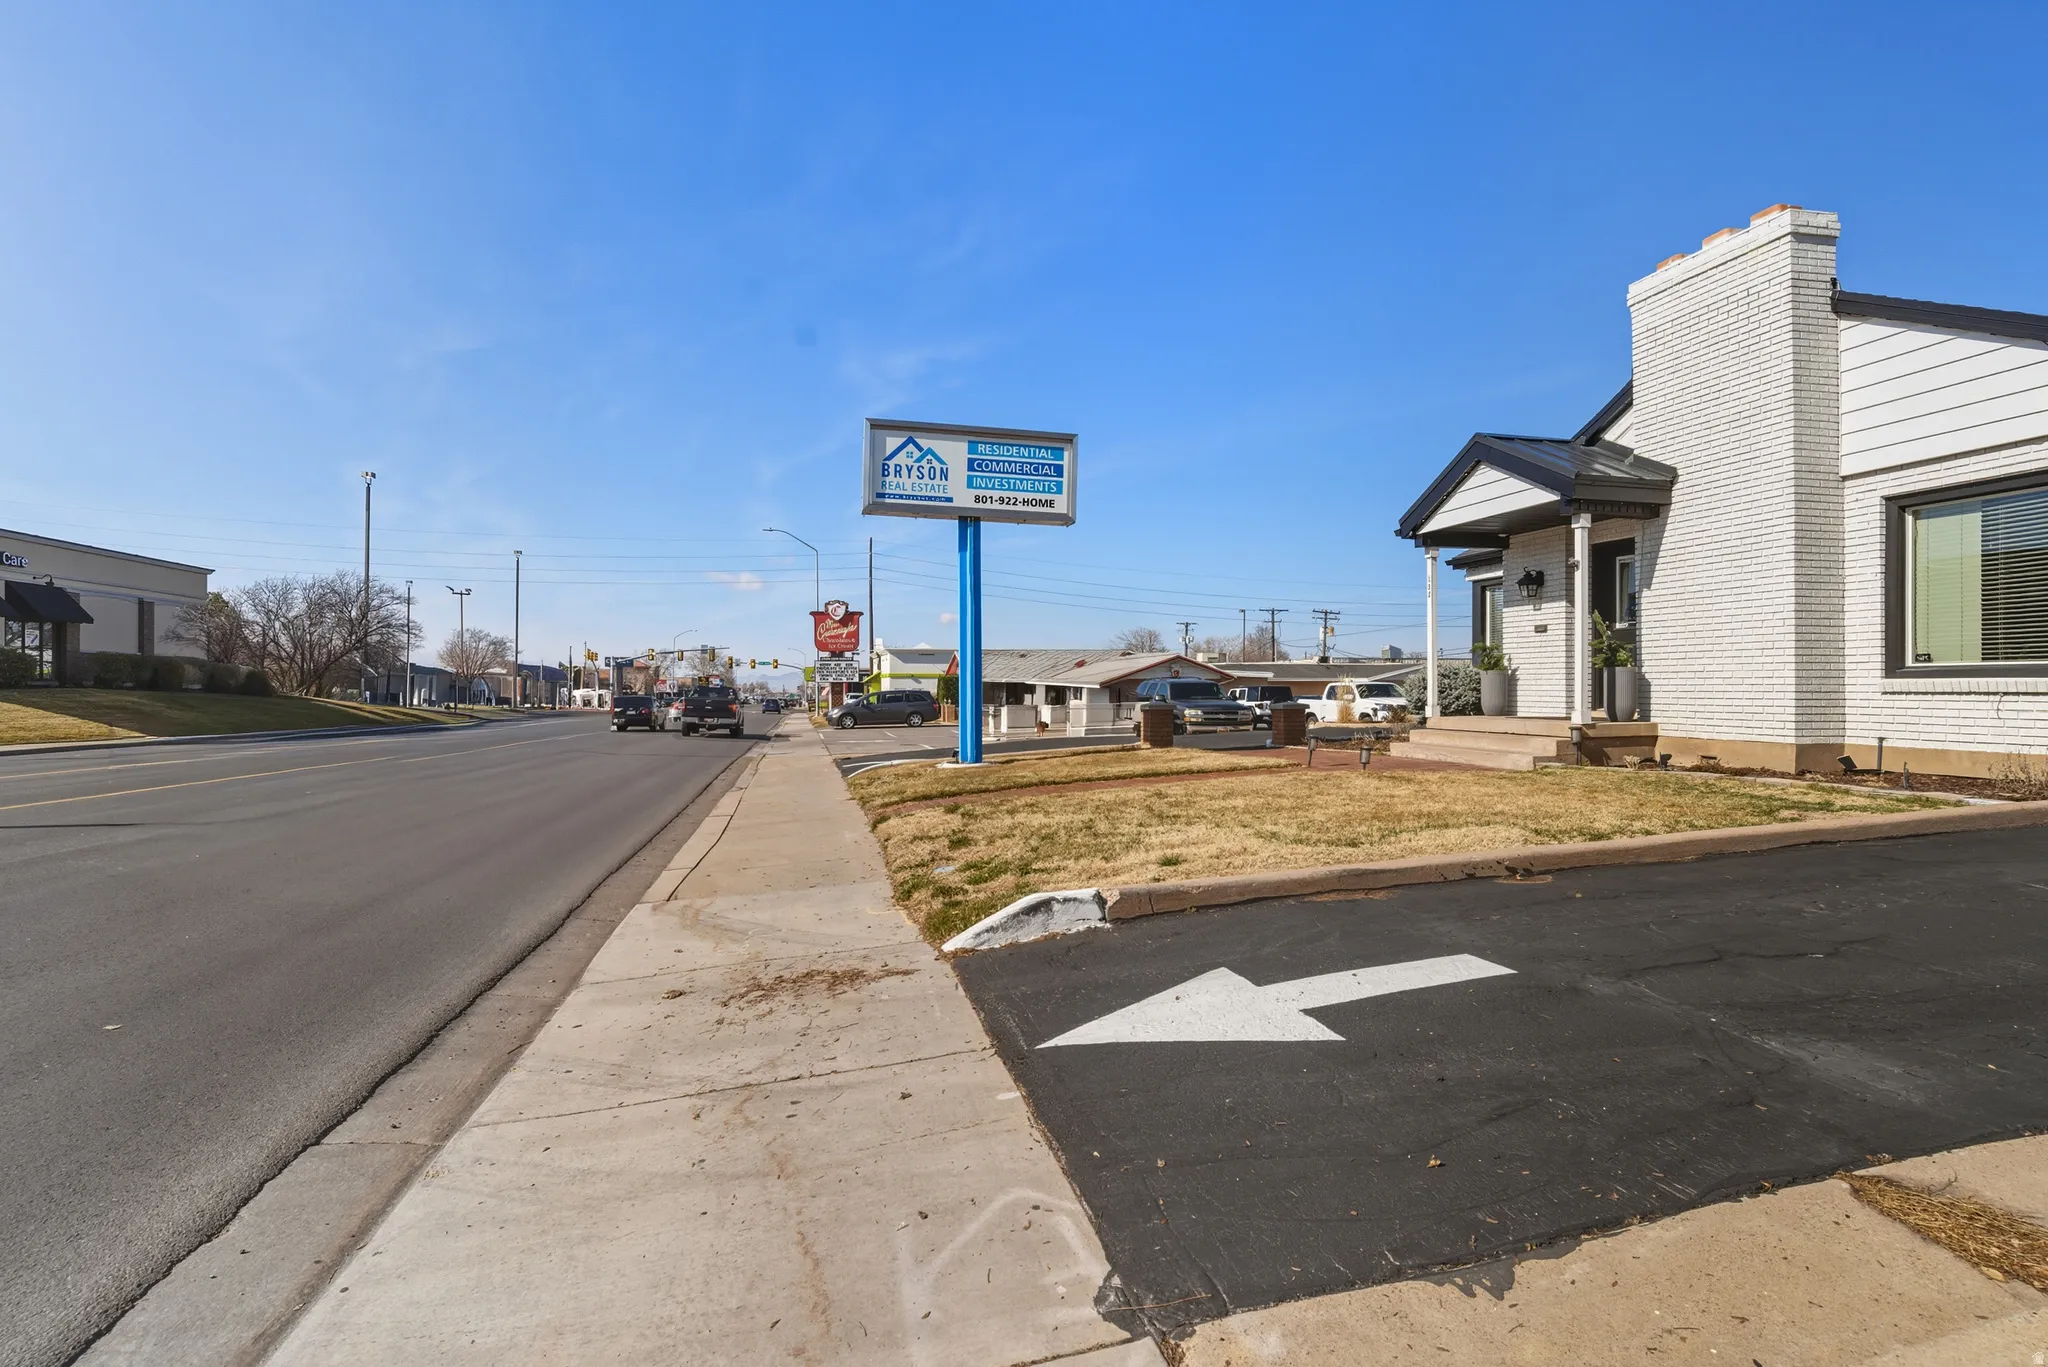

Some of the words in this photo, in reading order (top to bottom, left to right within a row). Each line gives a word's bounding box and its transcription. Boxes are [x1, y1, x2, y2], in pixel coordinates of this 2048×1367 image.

[978, 443, 1054, 459] RESIDENTIAL
[881, 462, 949, 482] BRYSON
[974, 460, 1057, 476] COMMERCIAL
[881, 480, 908, 492] REAL
[911, 482, 949, 494] ESTATE
[973, 477, 1057, 493] INVESTMENTS
[974, 494, 1056, 509] 801-922-HOME
[2, 552, 29, 568] Care
